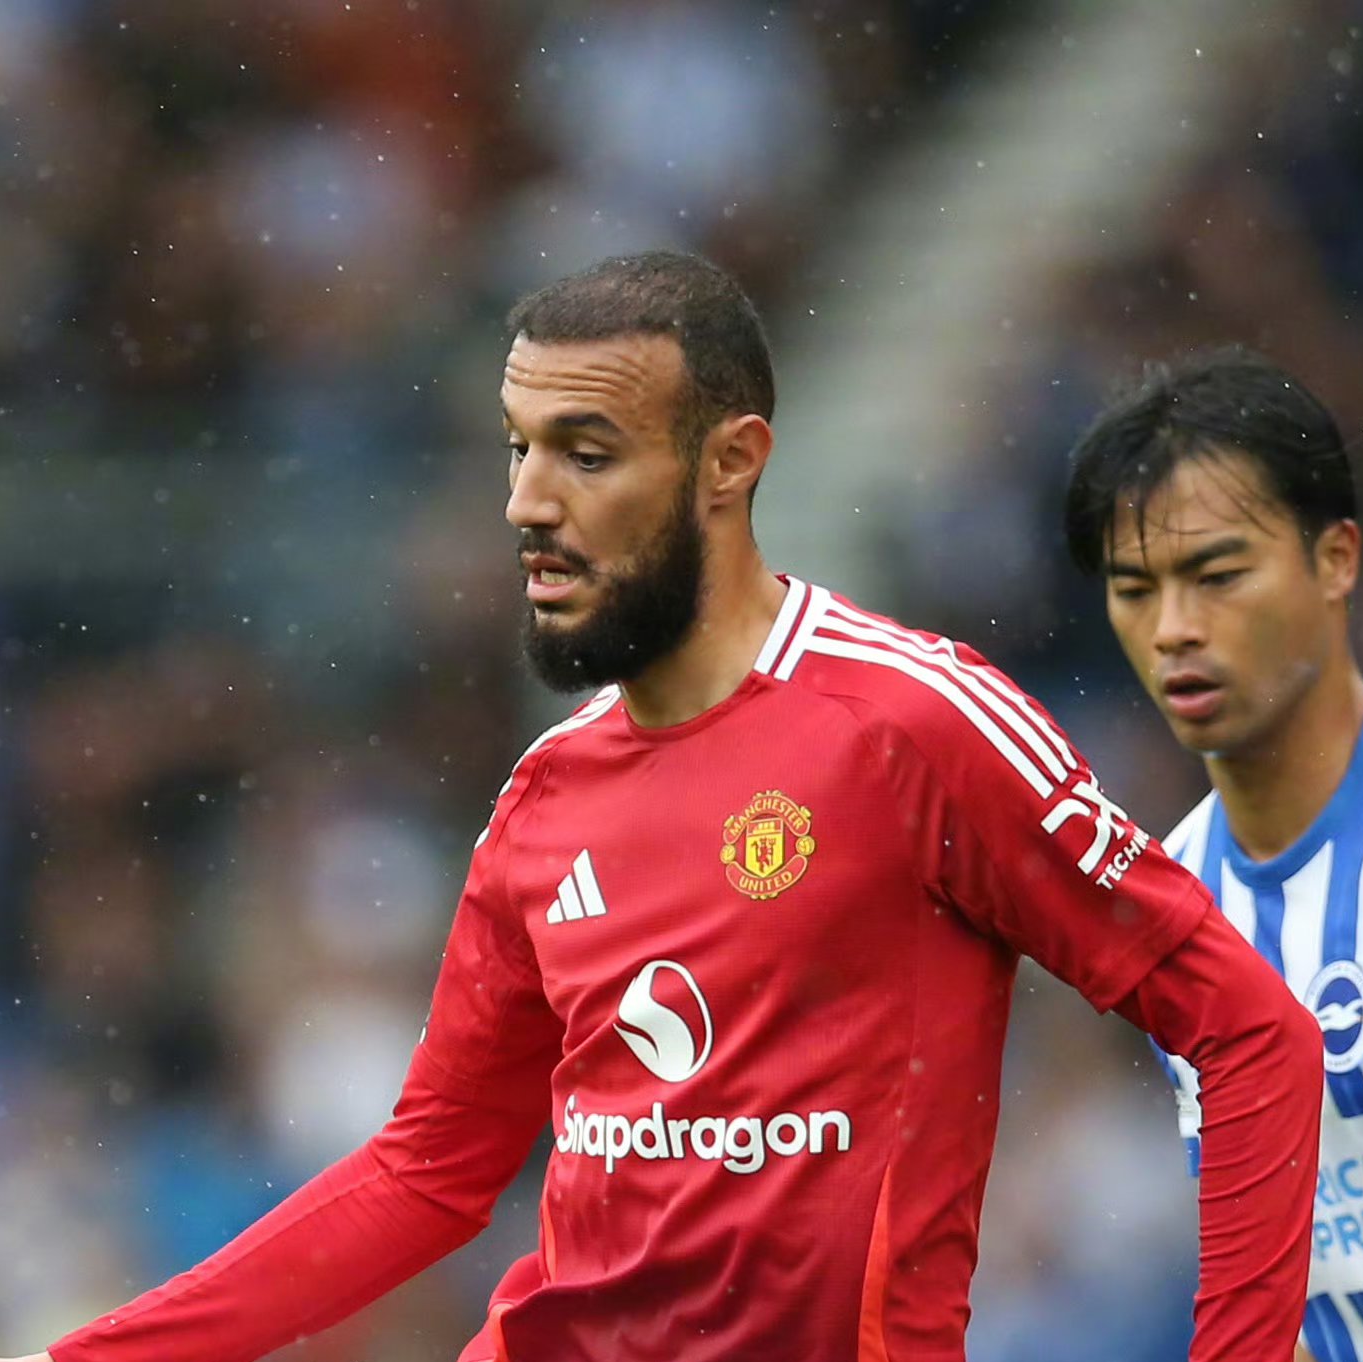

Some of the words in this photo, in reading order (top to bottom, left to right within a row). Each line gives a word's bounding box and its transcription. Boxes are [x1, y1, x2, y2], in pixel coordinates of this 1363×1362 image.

[729, 798, 804, 836] MANCHESTER
[739, 871, 793, 892] UNITED
[557, 1094, 851, 1174] Snapdragon
